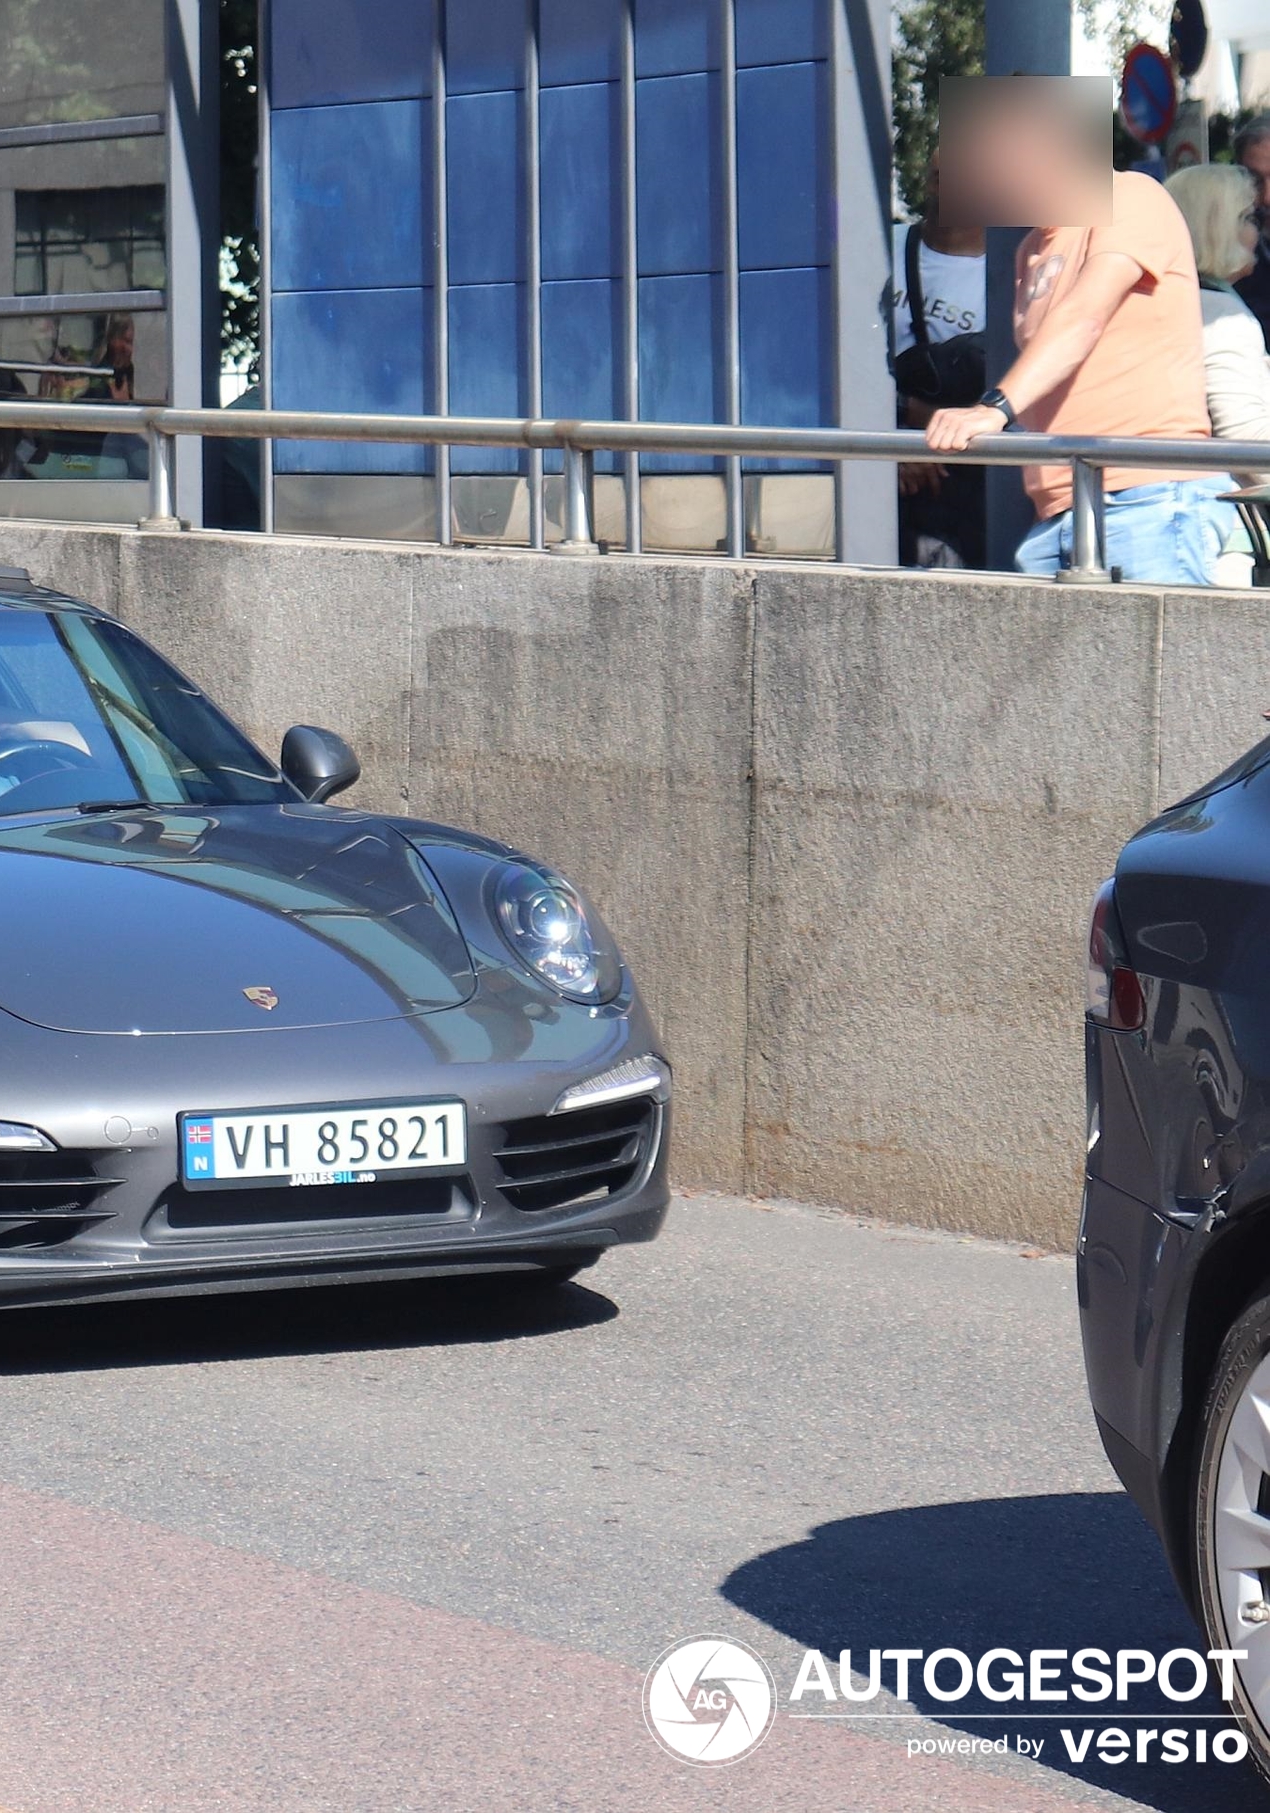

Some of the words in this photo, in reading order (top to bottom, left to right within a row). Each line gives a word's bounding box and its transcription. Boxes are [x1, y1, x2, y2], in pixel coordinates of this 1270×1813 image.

[226, 1124, 290, 1169] VH
[317, 1114, 449, 1164] 85821
[194, 1156, 208, 1171] N
